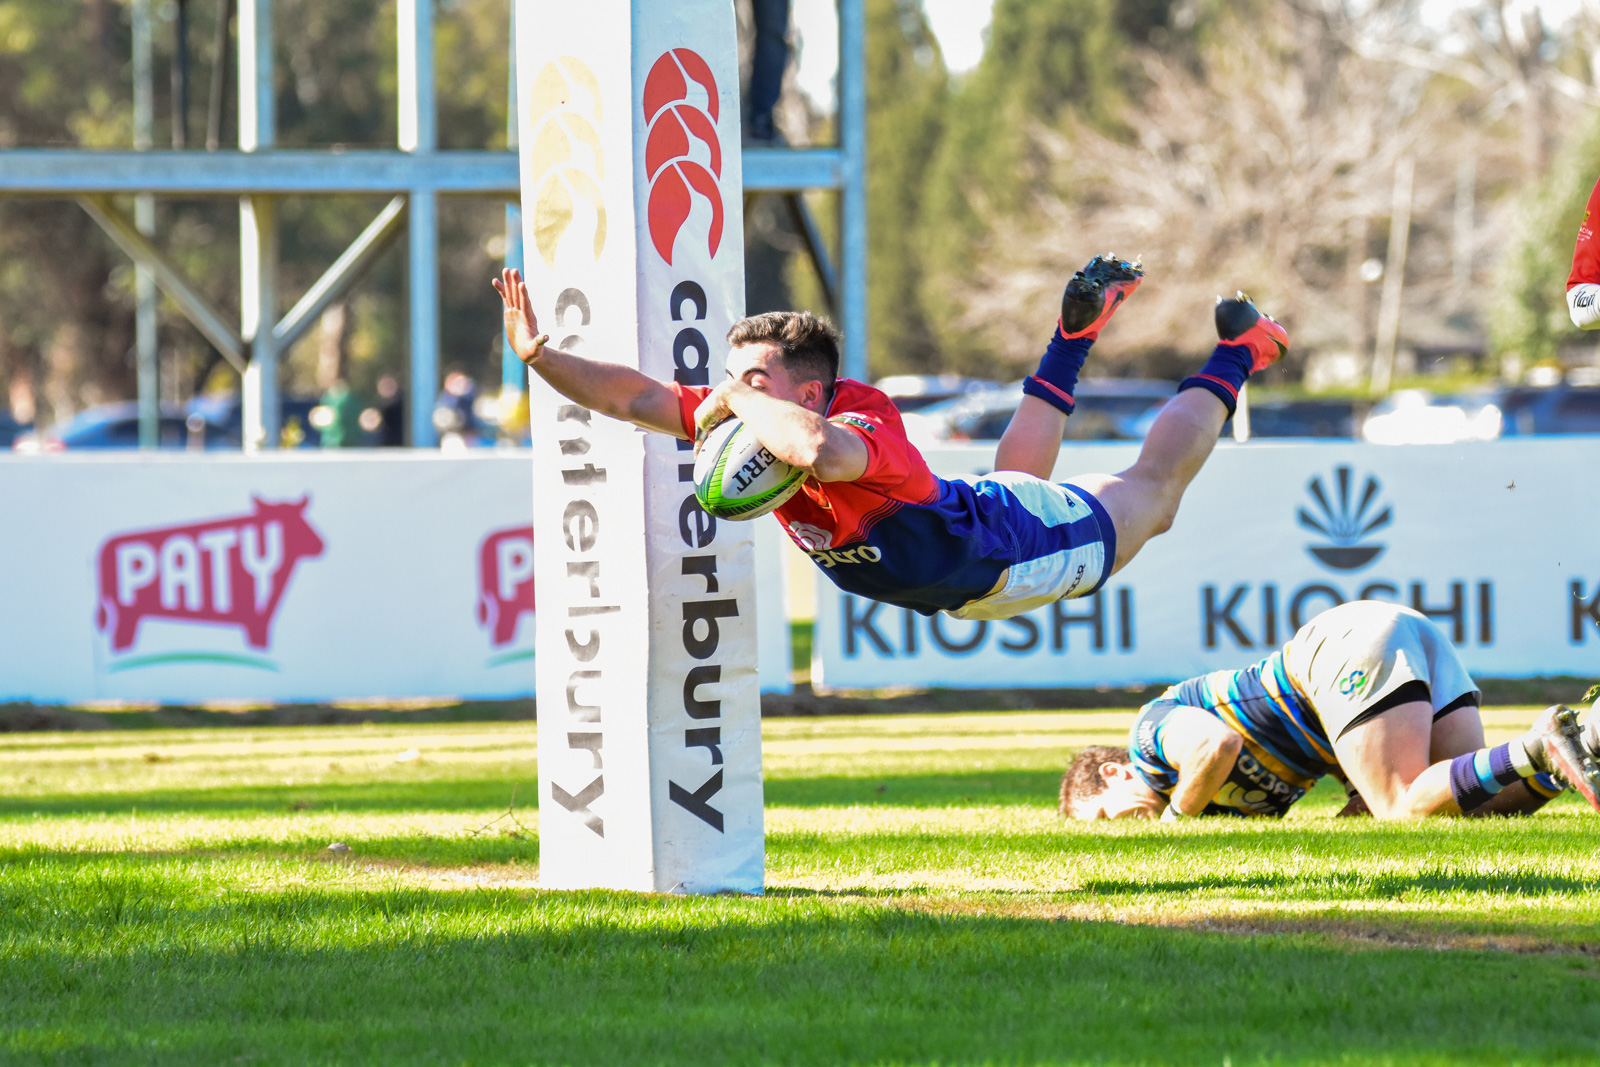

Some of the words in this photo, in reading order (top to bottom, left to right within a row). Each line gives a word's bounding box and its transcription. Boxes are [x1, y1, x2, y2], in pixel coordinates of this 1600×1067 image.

[731, 446, 777, 493] ERT
[116, 519, 283, 614] PATY
[550, 287, 621, 839] cnterbury
[668, 280, 739, 834] caerbury
[808, 545, 882, 568] acro
[1204, 582, 1490, 647] KIOHI
